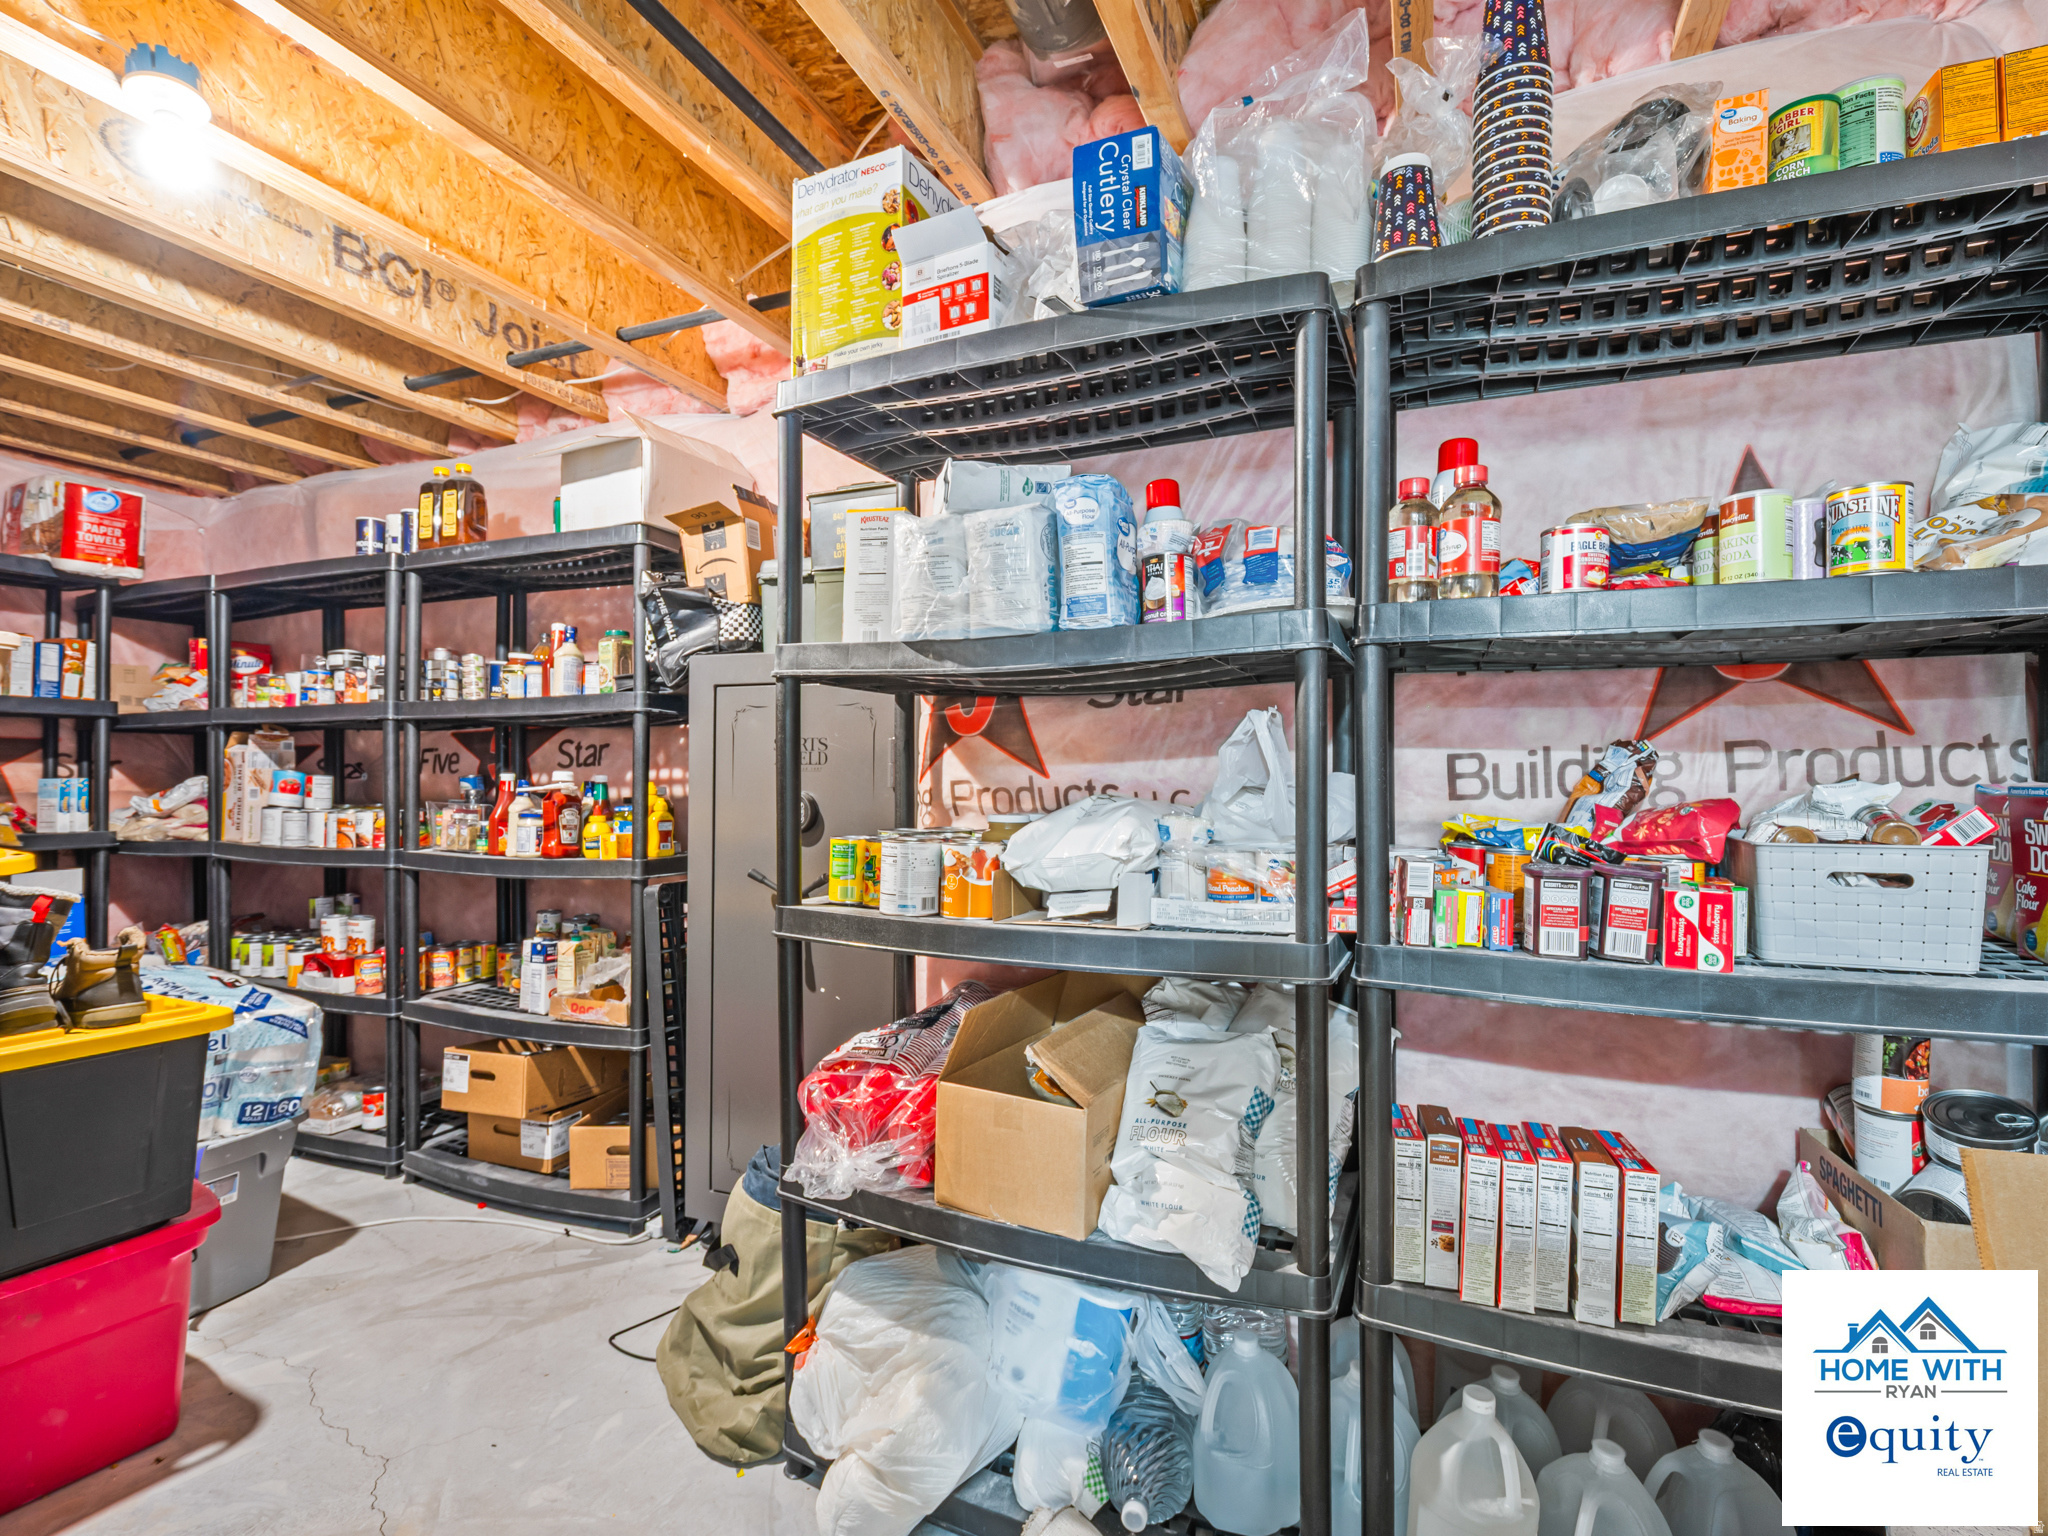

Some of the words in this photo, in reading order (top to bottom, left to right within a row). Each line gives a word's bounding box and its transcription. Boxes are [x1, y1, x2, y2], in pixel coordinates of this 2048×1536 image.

[1728, 114, 1758, 126] Baking
[1769, 107, 1815, 136] CLABBER
[1776, 118, 1801, 134] GIRL
[1119, 154, 1132, 196] Crystal
[1775, 167, 1811, 183] TARCH
[1776, 160, 1805, 177] CORN
[797, 167, 860, 199] Dehydrator
[860, 163, 886, 177] NESCO
[1095, 141, 1121, 232] Cutlery
[1122, 198, 1133, 230] Clear
[1138, 186, 1148, 227] KIRKLAND
[860, 515, 890, 524] KRUSTEAZ
[1721, 513, 1750, 526] Honeyville
[1827, 494, 1901, 532] SUNSHINE
[82, 522, 122, 536] PAPER
[989, 525, 1020, 538] SUGAR
[76, 531, 126, 547] TOWELS
[1145, 562, 1164, 572] THAI
[656, 595, 668, 615] THE
[663, 614, 677, 641] WALL
[420, 747, 460, 775] Five
[557, 738, 610, 768] Star
[1447, 744, 1687, 807] Buildg
[1724, 730, 2032, 794] Products
[950, 775, 1120, 818] Products
[1223, 883, 1250, 893] Peaches
[2015, 878, 2037, 898] Cake
[2015, 894, 2040, 911] Flour
[1711, 904, 1724, 944] strawberry
[1674, 917, 1686, 957] strawberry
[244, 1104, 263, 1117] 12
[272, 1099, 300, 1115] 160
[1134, 1117, 1188, 1129] ALL-PURPOSE
[1129, 1125, 1188, 1147] FLOUR
[1583, 1190, 1601, 1198] Calories
[1819, 1155, 1883, 1228] SPAGHETTI
[1141, 1200, 1159, 1208] WHITE
[1161, 1201, 1183, 1211] FLOUR
